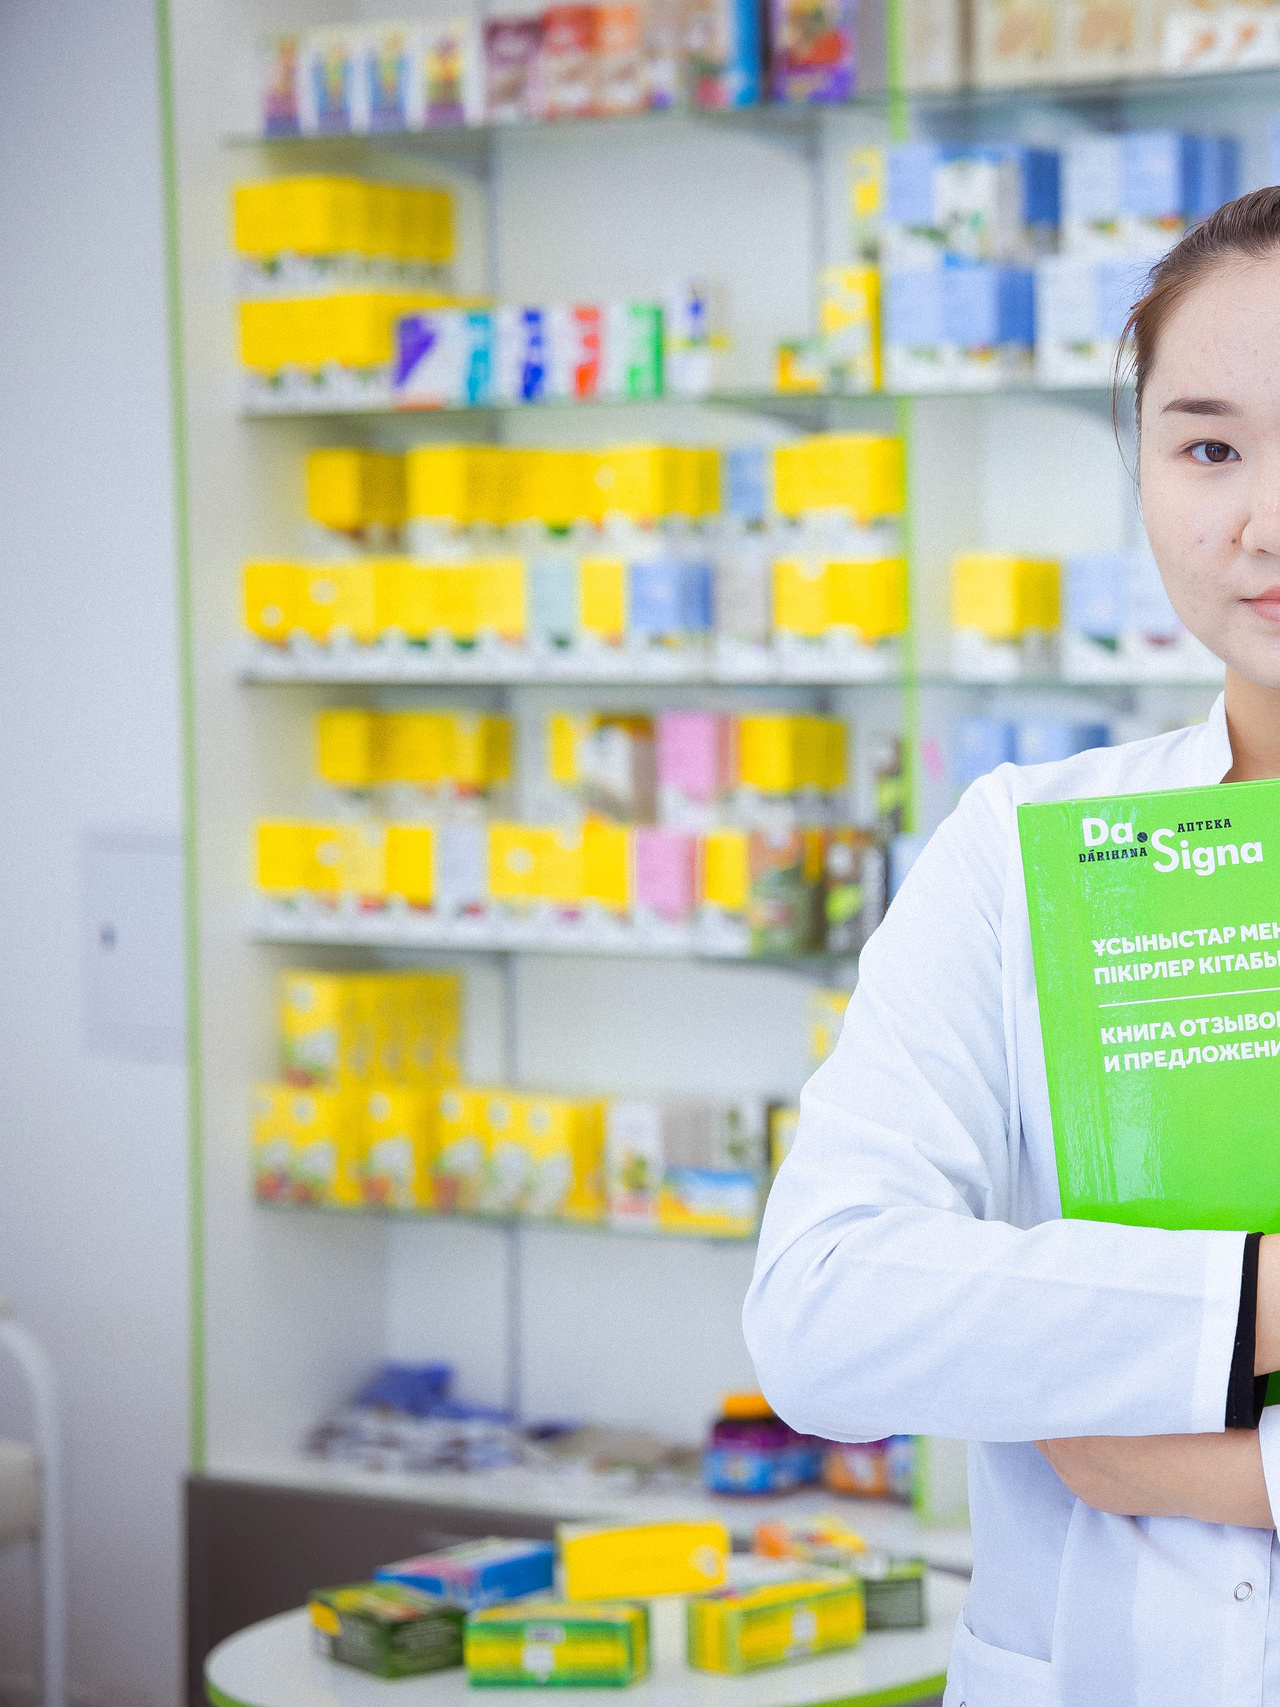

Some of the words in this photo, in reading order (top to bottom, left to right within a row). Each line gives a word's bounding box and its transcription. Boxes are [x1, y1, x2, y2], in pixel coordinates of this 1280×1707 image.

[1177, 818, 1232, 833] АПТЕКА
[1151, 828, 1264, 877] Signa
[1091, 925, 1236, 957] ҰСЫНЫСТАР
[1093, 958, 1195, 985] ПІКІРЛЕР
[1100, 1021, 1176, 1045] КНИГА
[1103, 1055, 1120, 1073] И
